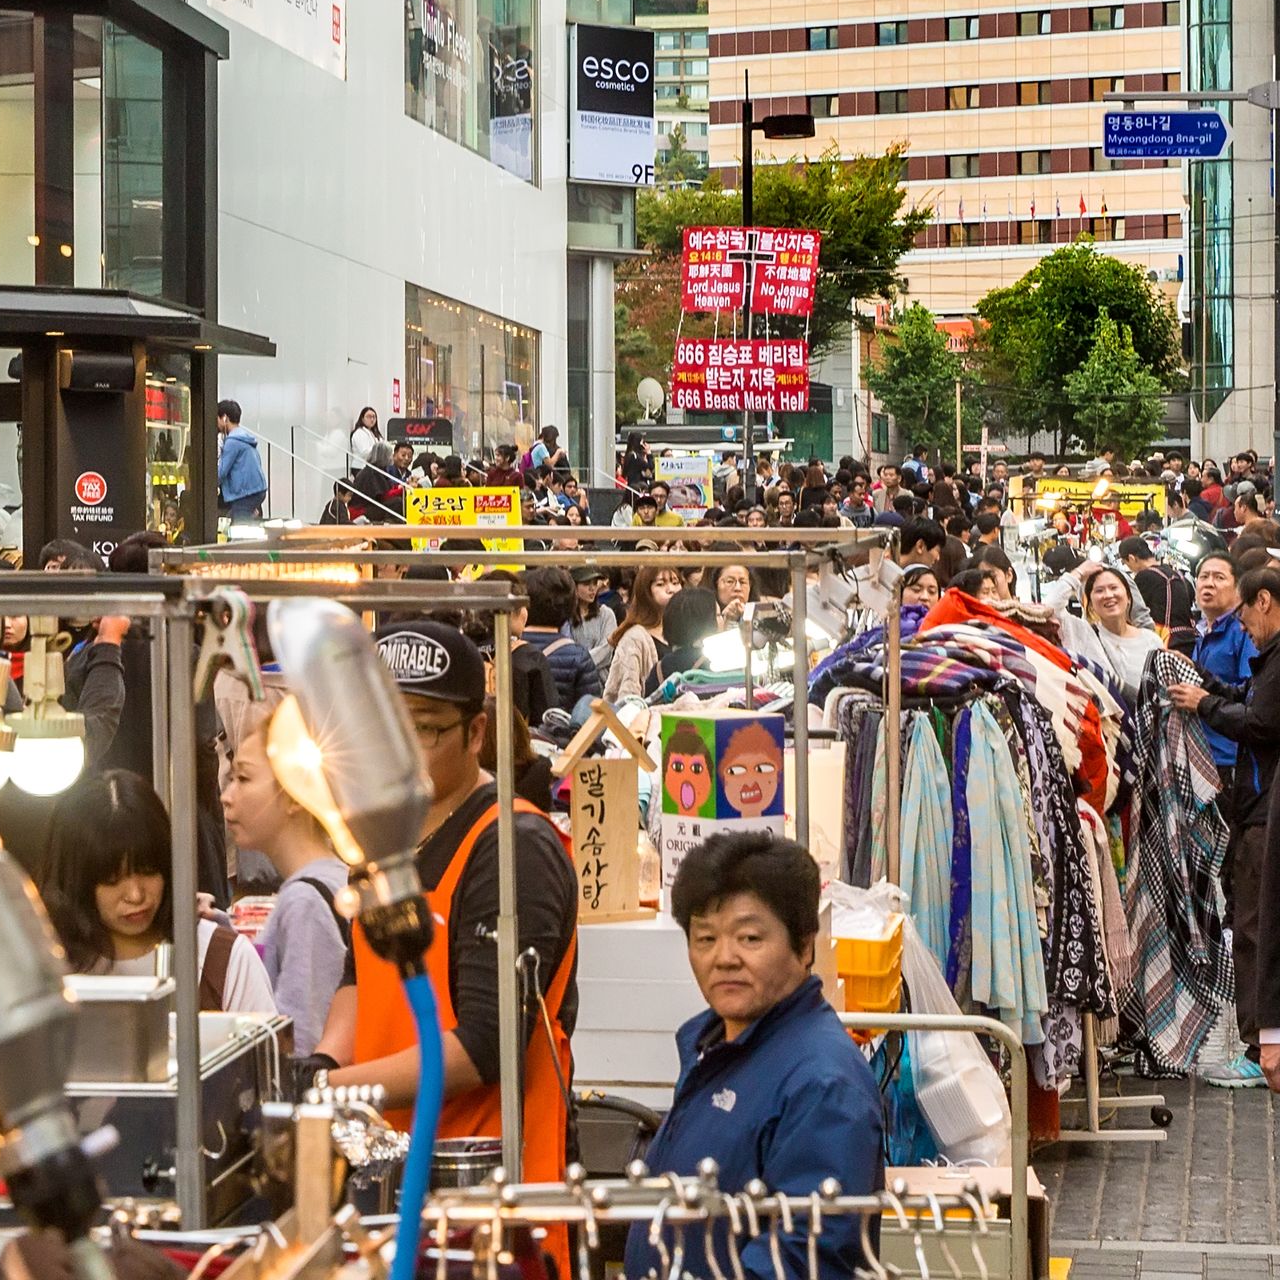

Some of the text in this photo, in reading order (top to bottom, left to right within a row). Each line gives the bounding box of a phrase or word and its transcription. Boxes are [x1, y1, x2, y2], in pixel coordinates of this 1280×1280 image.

[582, 56, 649, 83] esco
[595, 80, 635, 92] cosmetics
[1108, 115, 1171, 131] 명동8나길
[1108, 133, 1212, 145] Myeongdong 8na-gil
[632, 163, 654, 185] 9F
[689, 231, 815, 252] 예수천국 불신지옥
[687, 280, 809, 299] Lord Jesus No Jesus
[695, 294, 793, 309] Heaven Hell
[677, 343, 803, 367] 666 짐승표 베리칩
[705, 367, 776, 391] 받는자 지옥
[677, 388, 804, 410] 666 Beast Mark Hell
[73, 514, 113, 522] TAX REFUND
[579, 764, 609, 909] 딸기솜사탕
